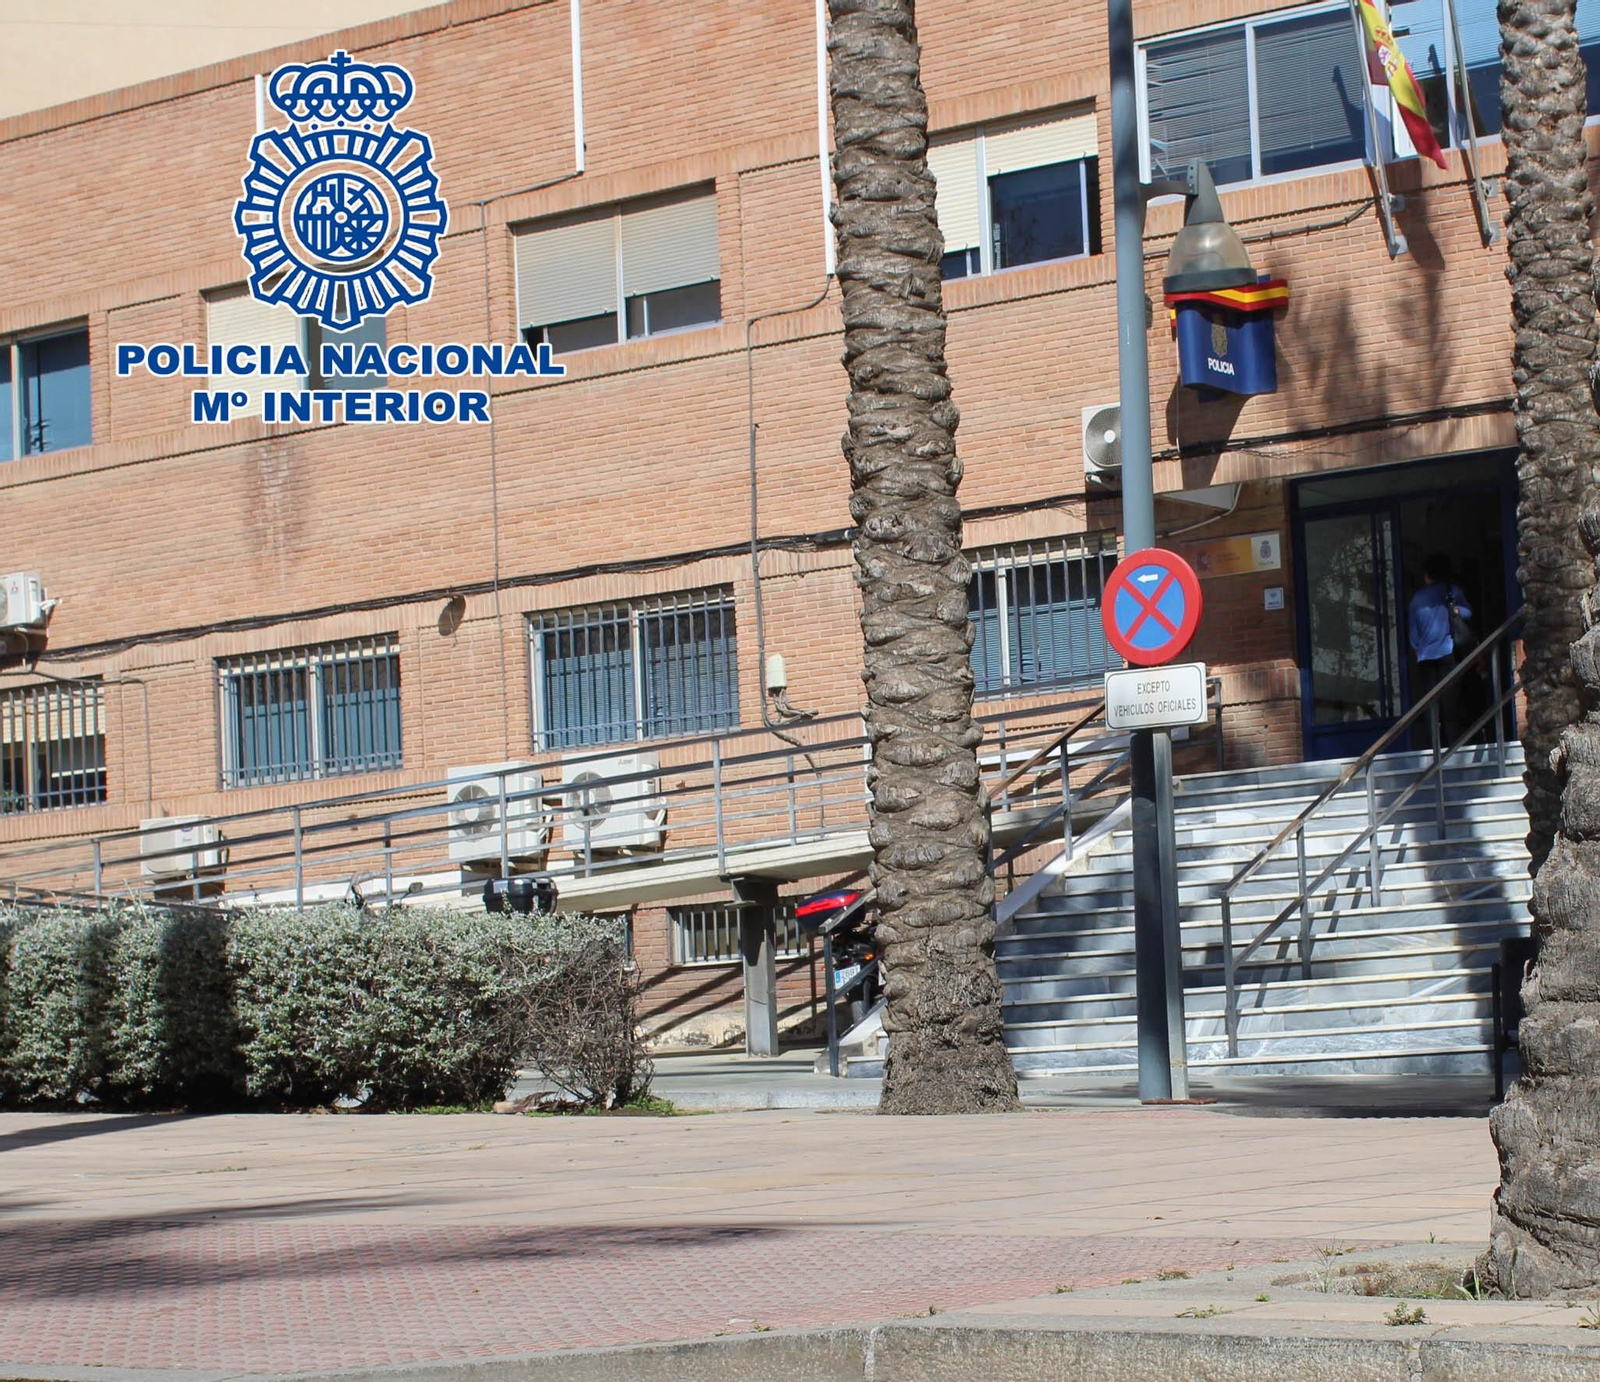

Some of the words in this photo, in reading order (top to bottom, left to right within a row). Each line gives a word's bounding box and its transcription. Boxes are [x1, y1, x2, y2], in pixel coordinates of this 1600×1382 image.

[1208, 357, 1235, 376] POLICIA
[1137, 681, 1171, 694] EXCEPTO
[1114, 702, 1155, 717] VEHICULOS
[1158, 698, 1197, 713] OFICIALES
